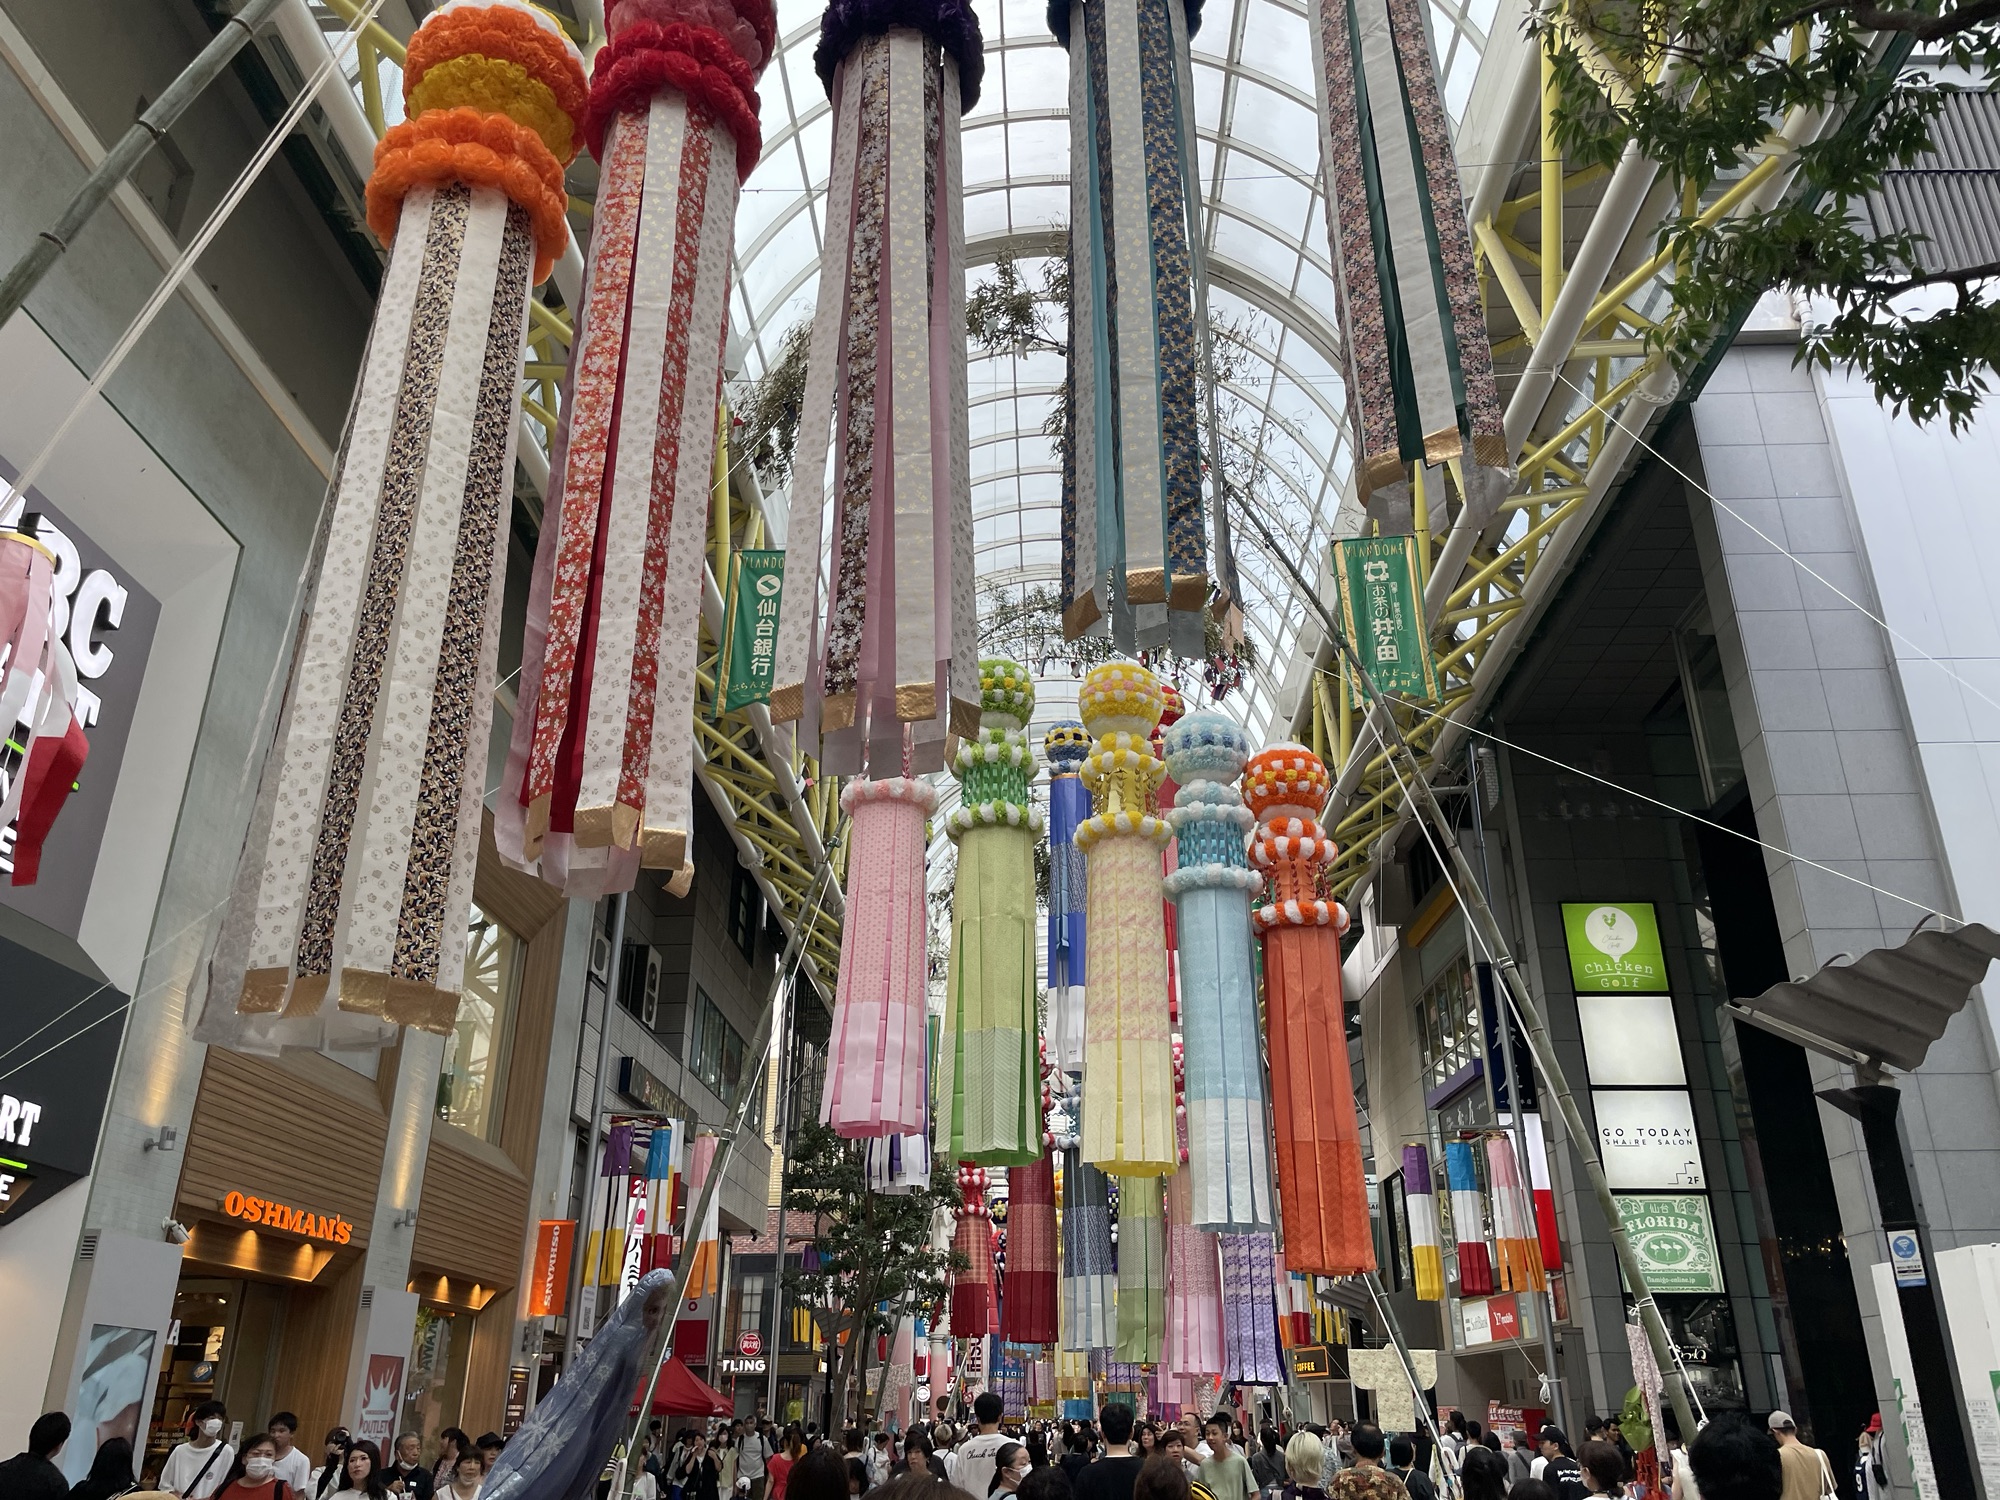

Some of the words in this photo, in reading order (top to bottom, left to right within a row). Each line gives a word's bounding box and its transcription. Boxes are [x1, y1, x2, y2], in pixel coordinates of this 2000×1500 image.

[751, 598, 777, 676] 仙台銀行
[1584, 961, 1653, 974] Chicken
[1600, 977, 1639, 988] Golf
[1602, 1128, 1624, 1137] GO
[1636, 1128, 1691, 1137] TODAY
[1687, 1176, 1700, 1185] 2F
[1649, 1203, 1669, 1214] 仙台
[225, 1190, 353, 1245] OSHMAN'S
[1624, 1215, 1700, 1235] FLORIDA
[543, 1225, 560, 1309] OSHMAN'S
[1296, 1362, 1315, 1372] COFFEE
[363, 1420, 389, 1434] OUTLET
